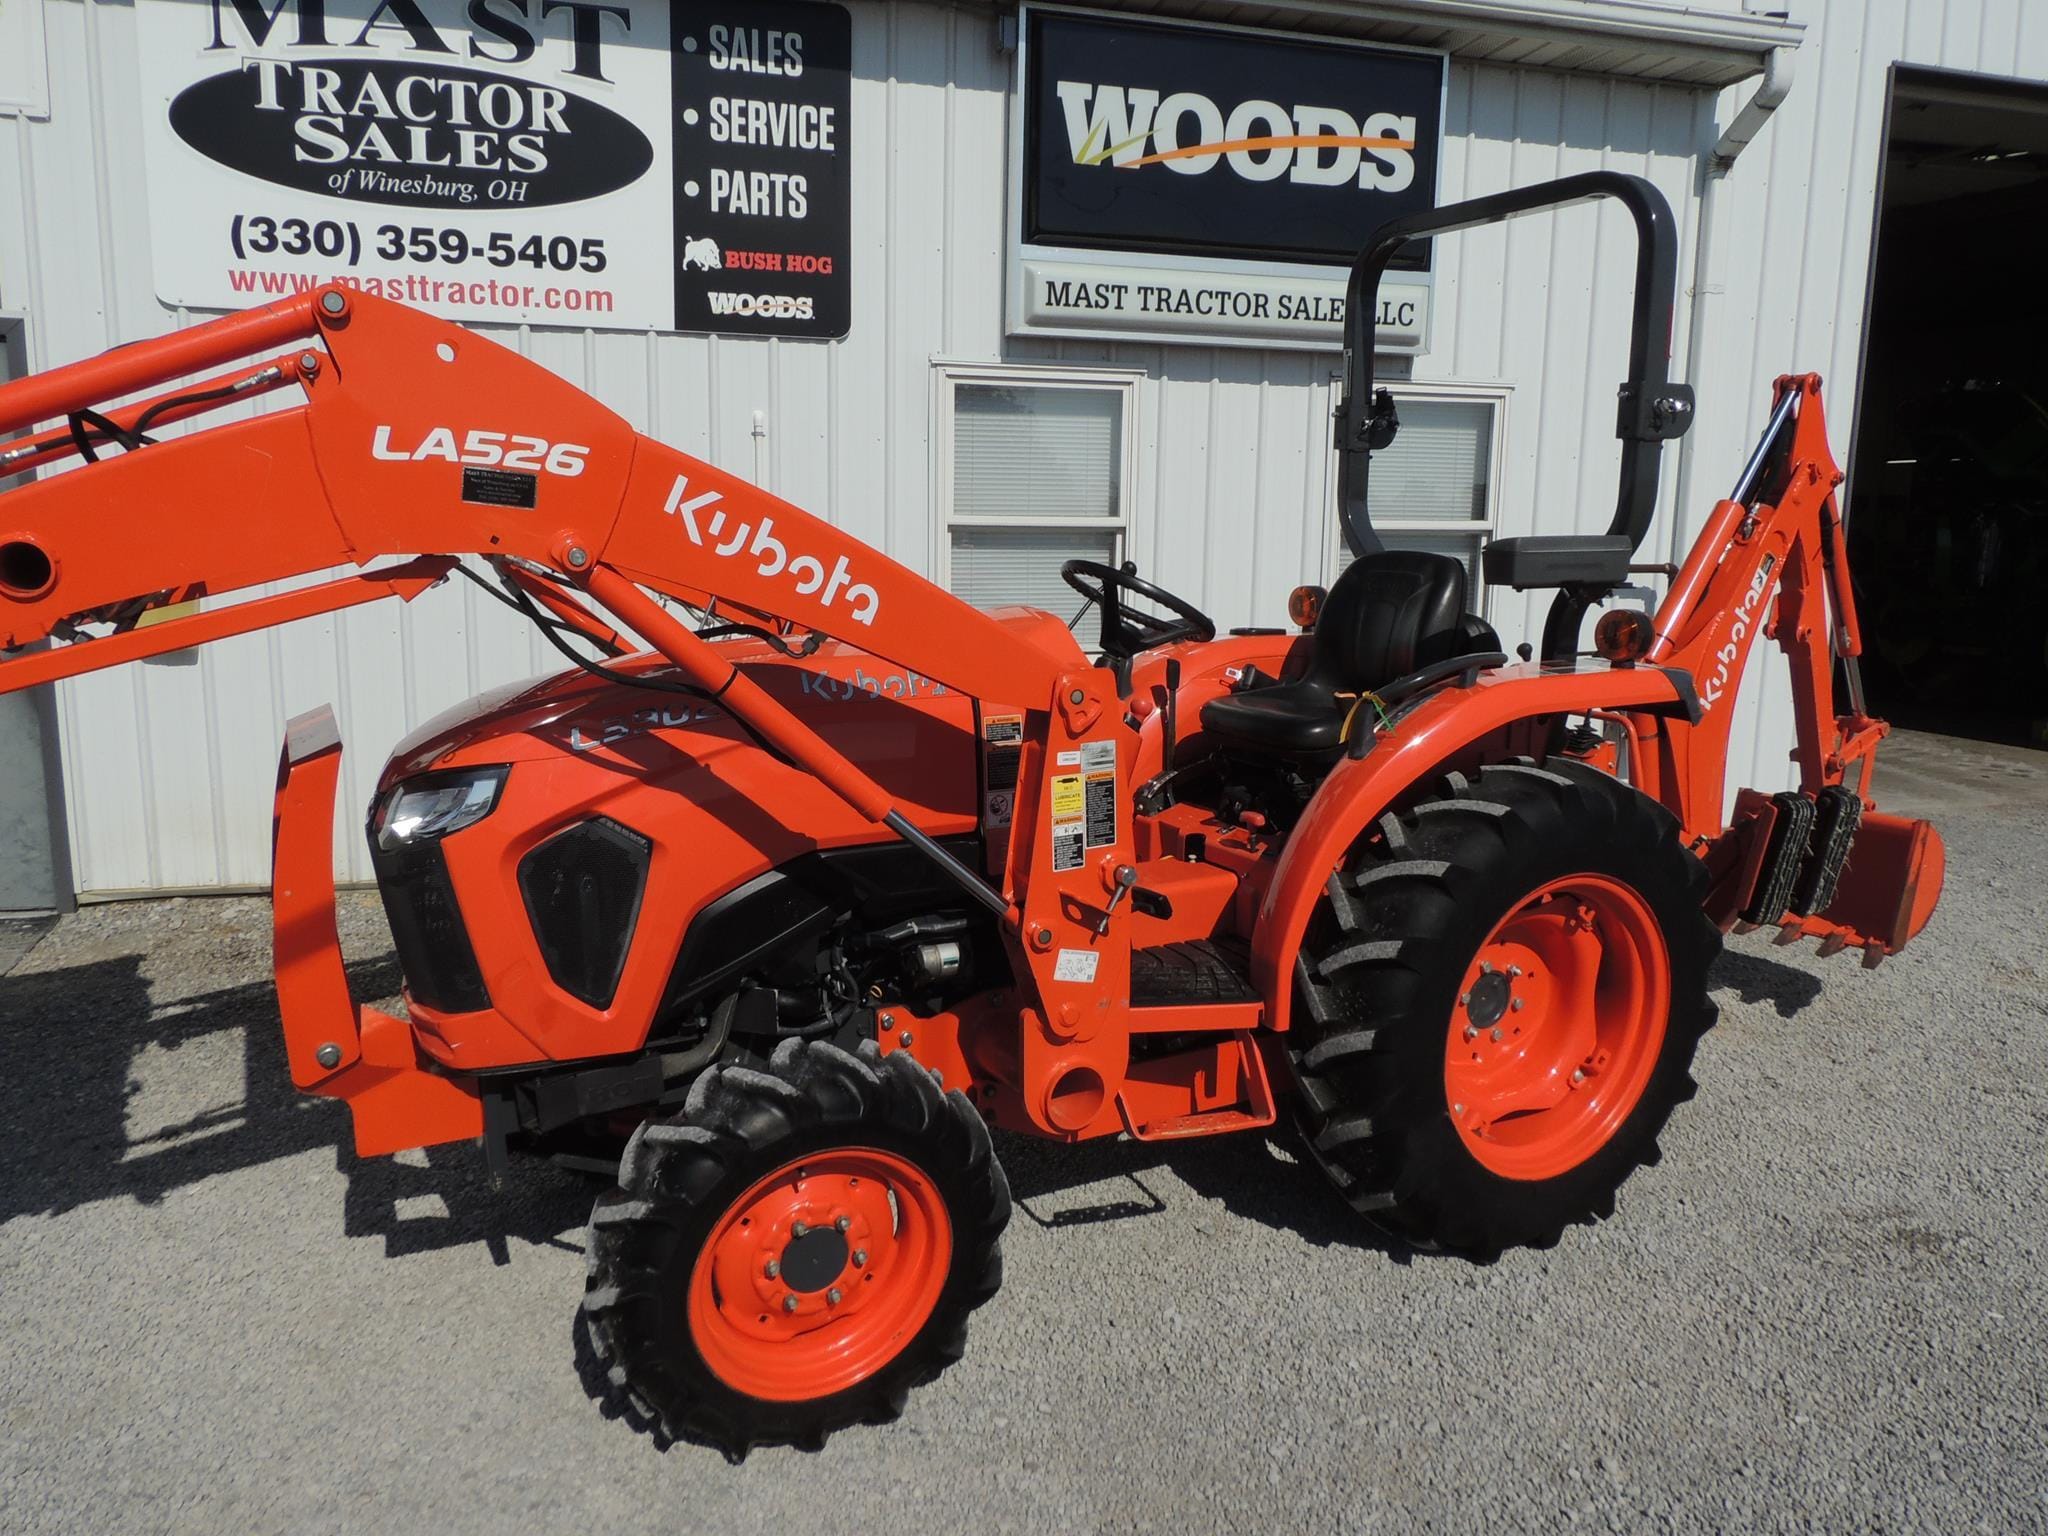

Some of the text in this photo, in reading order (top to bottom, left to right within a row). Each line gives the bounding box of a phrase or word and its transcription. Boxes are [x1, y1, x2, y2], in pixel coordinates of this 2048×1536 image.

[203, 0, 631, 84] MAST
[708, 24, 804, 77] SALES
[241, 56, 572, 134] TRACTOR
[294, 114, 549, 173] SALES
[709, 96, 835, 152] SERVICE
[1056, 80, 1417, 193] WOODS
[327, 170, 529, 202] of Winesburg, OH
[710, 168, 808, 219] PARTS
[229, 214, 608, 272] (330) 359-5405
[725, 250, 833, 274] BUSH HOG
[228, 269, 614, 312] wwwmasttractor.com
[707, 291, 815, 320] WOODS
[1045, 281, 1128, 311] MAST
[1137, 286, 1271, 318] TRACTOR
[1277, 294, 1347, 323] SALE
[371, 425, 591, 477] LA526
[662, 474, 880, 626] Kubota
[1699, 587, 1762, 711] Kubota
